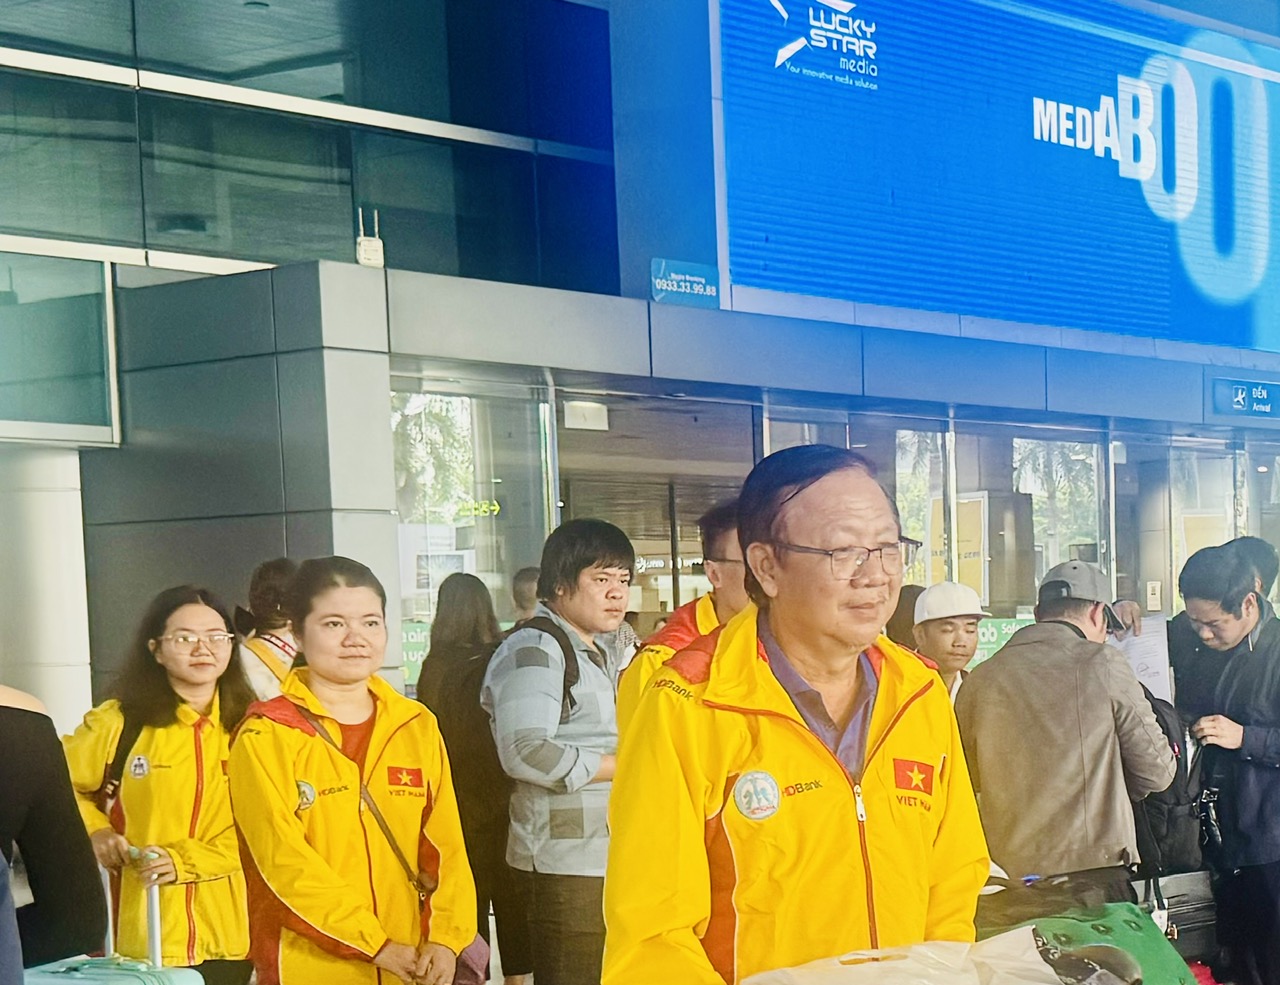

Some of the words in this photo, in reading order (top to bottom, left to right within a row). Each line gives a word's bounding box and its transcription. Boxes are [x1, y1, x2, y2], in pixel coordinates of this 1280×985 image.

[809, 7, 876, 38] LUCKY
[810, 28, 877, 59] STAR
[839, 57, 878, 76] media
[896, 795, 917, 807] VIET
